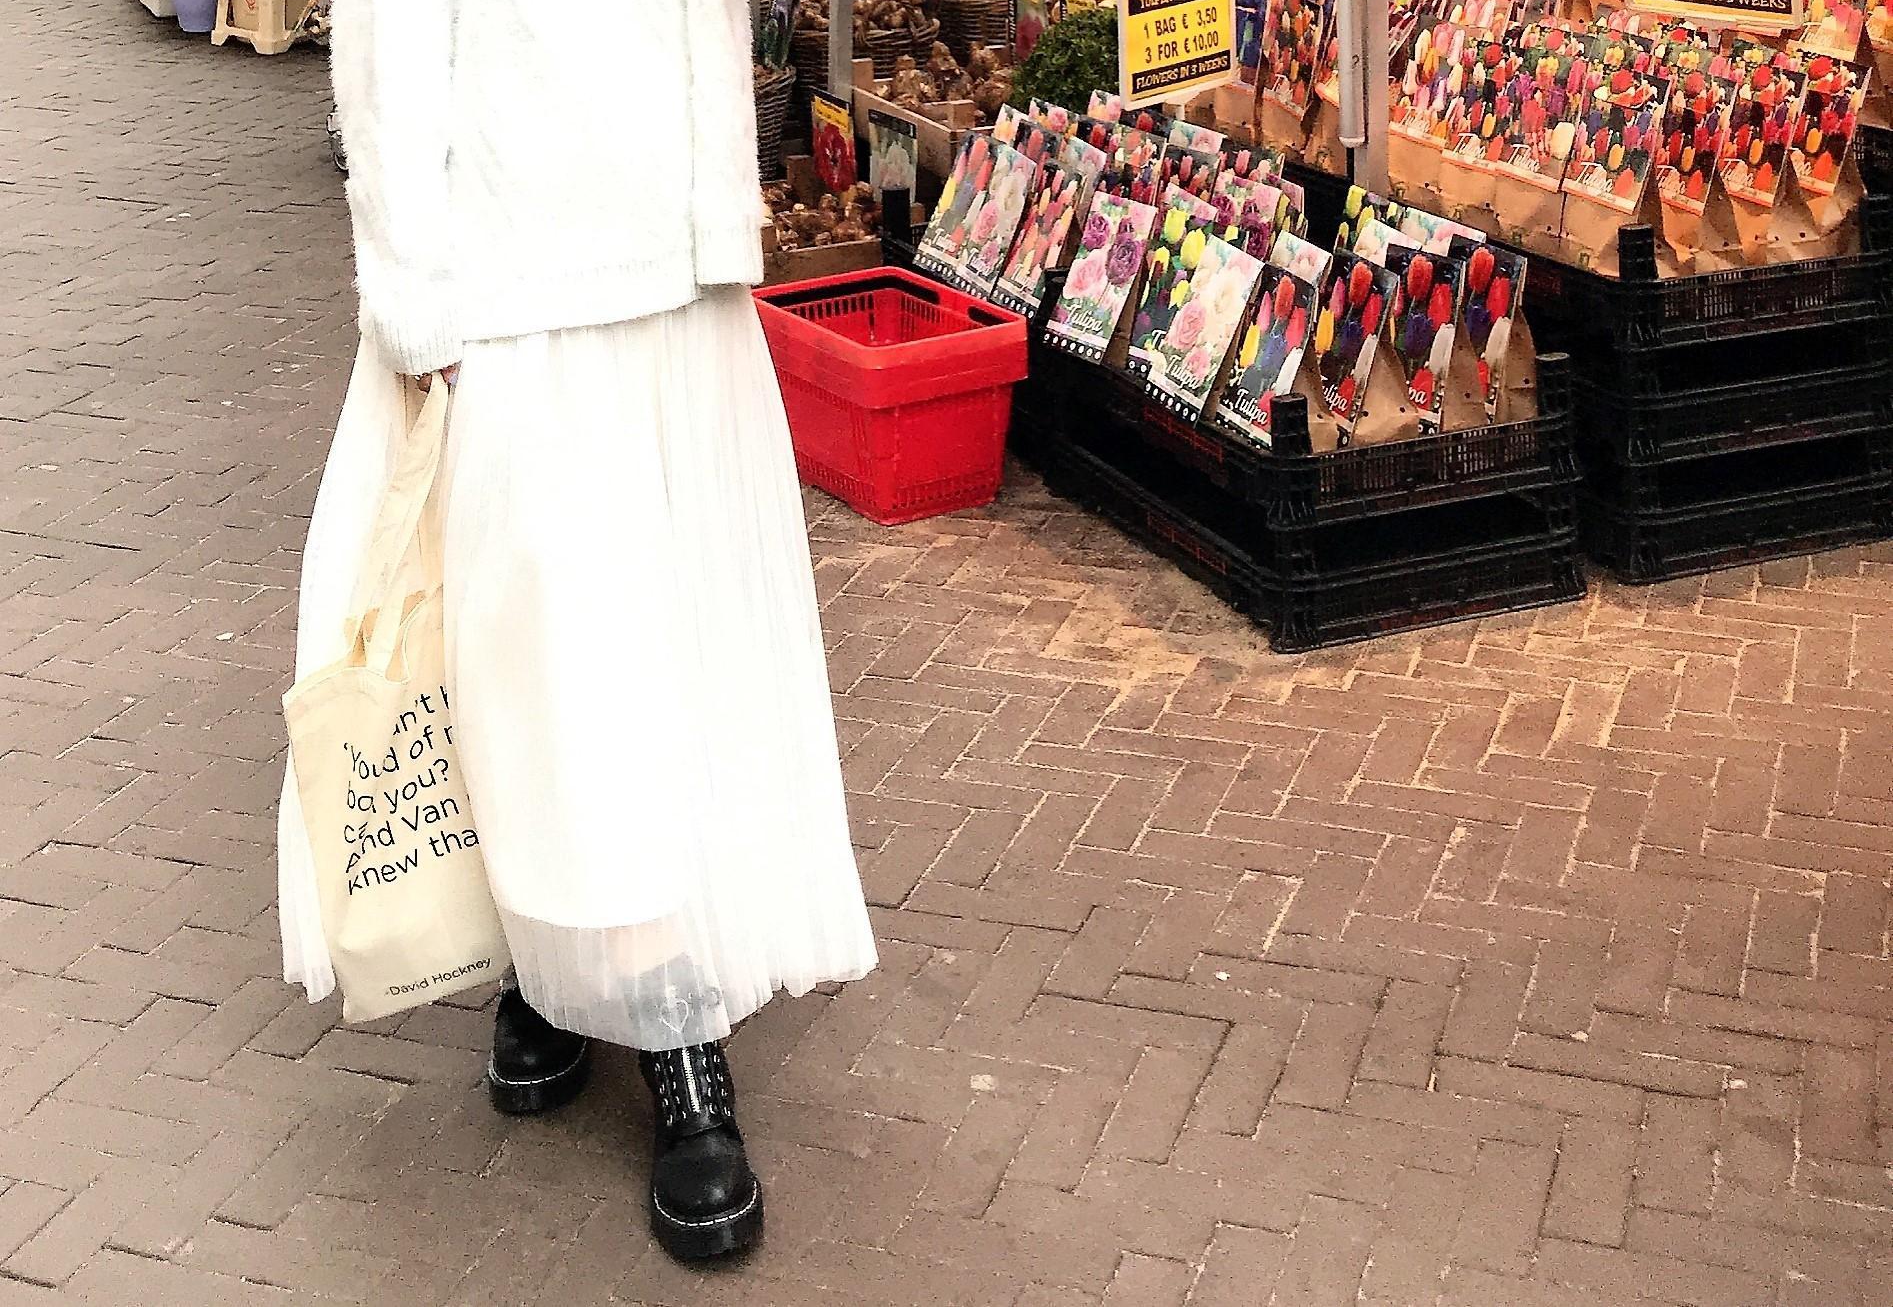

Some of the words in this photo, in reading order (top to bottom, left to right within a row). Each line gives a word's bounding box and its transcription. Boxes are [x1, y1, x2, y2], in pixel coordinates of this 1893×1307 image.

[1143, 22, 1150, 39] 1
[1155, 16, 1177, 36] BAG
[1182, 14, 1189, 29] €
[1196, 7, 1217, 28] 3,50
[1145, 47, 1152, 64] 3
[1158, 41, 1179, 61] FOR
[1184, 38, 1191, 54] €
[1193, 31, 1219, 52] 10,00
[1136, 68, 1179, 89] FLOWERS
[1179, 64, 1190, 79] IN
[1191, 63, 1198, 76] 3
[1199, 55, 1228, 73] WEEKS
[1067, 303, 1103, 333] Tulipa
[1166, 354, 1201, 391] Tulipa
[1234, 388, 1269, 425] Tulipa
[1321, 383, 1348, 412] ulipa
[409, 724, 433, 760] of
[384, 758, 449, 814] you?
[401, 798, 459, 831] Van
[349, 848, 418, 896] knew
[429, 829, 480, 857] tha
